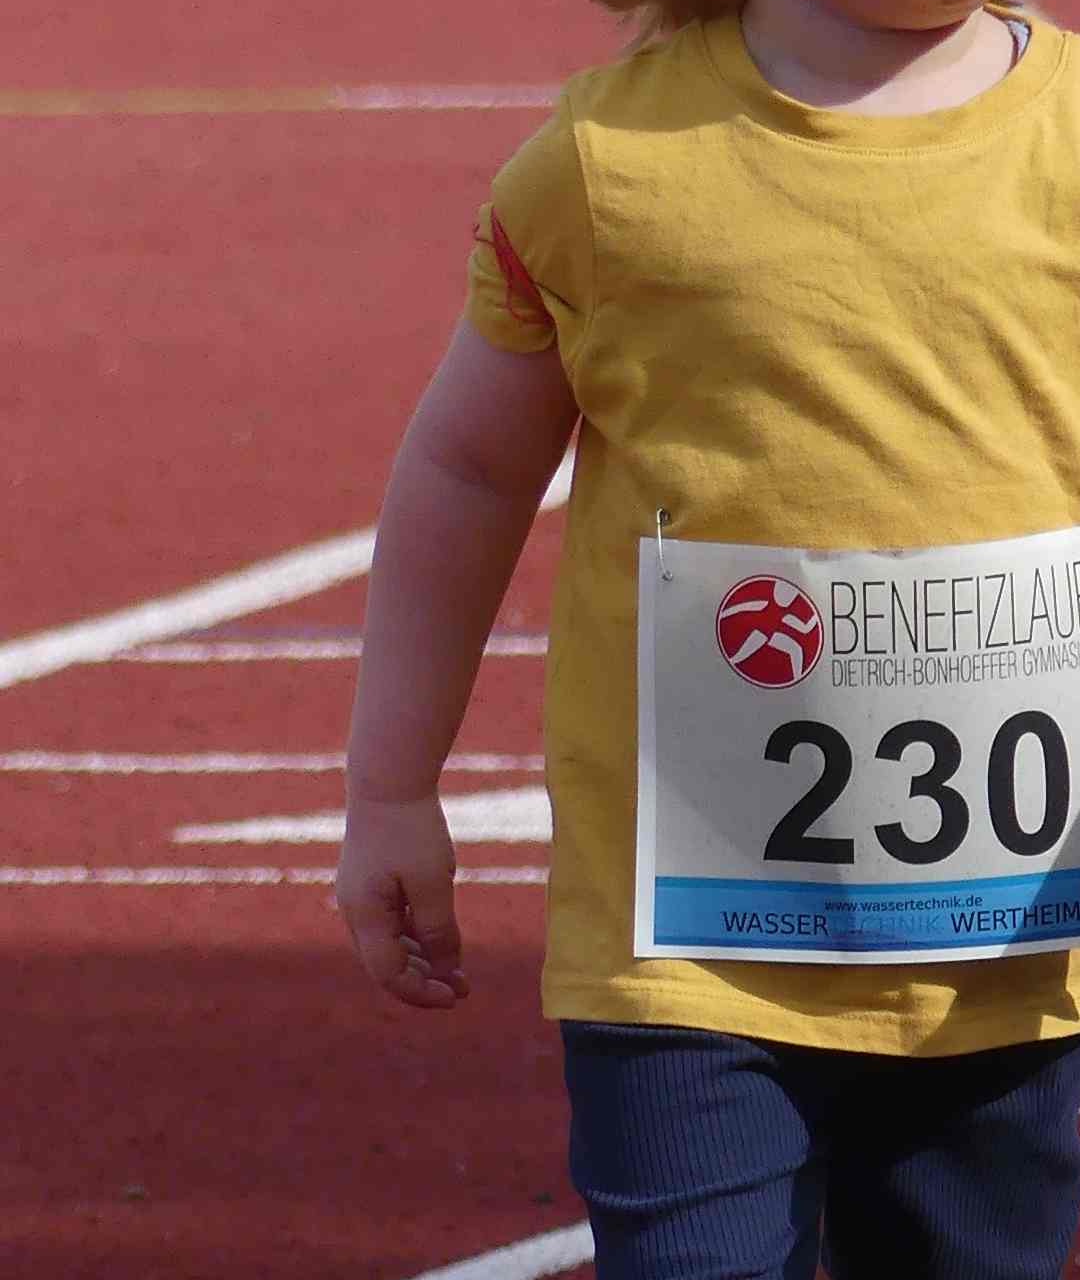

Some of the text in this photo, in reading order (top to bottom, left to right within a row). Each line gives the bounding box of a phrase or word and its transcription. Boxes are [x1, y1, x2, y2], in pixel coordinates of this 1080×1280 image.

[831, 651, 1017, 688] DIETRICH-BONHOEFFER
[764, 710, 1071, 865] 230
[824, 895, 983, 912] www.wassertechnik.de
[950, 901, 1080, 933] WERTHEIM
